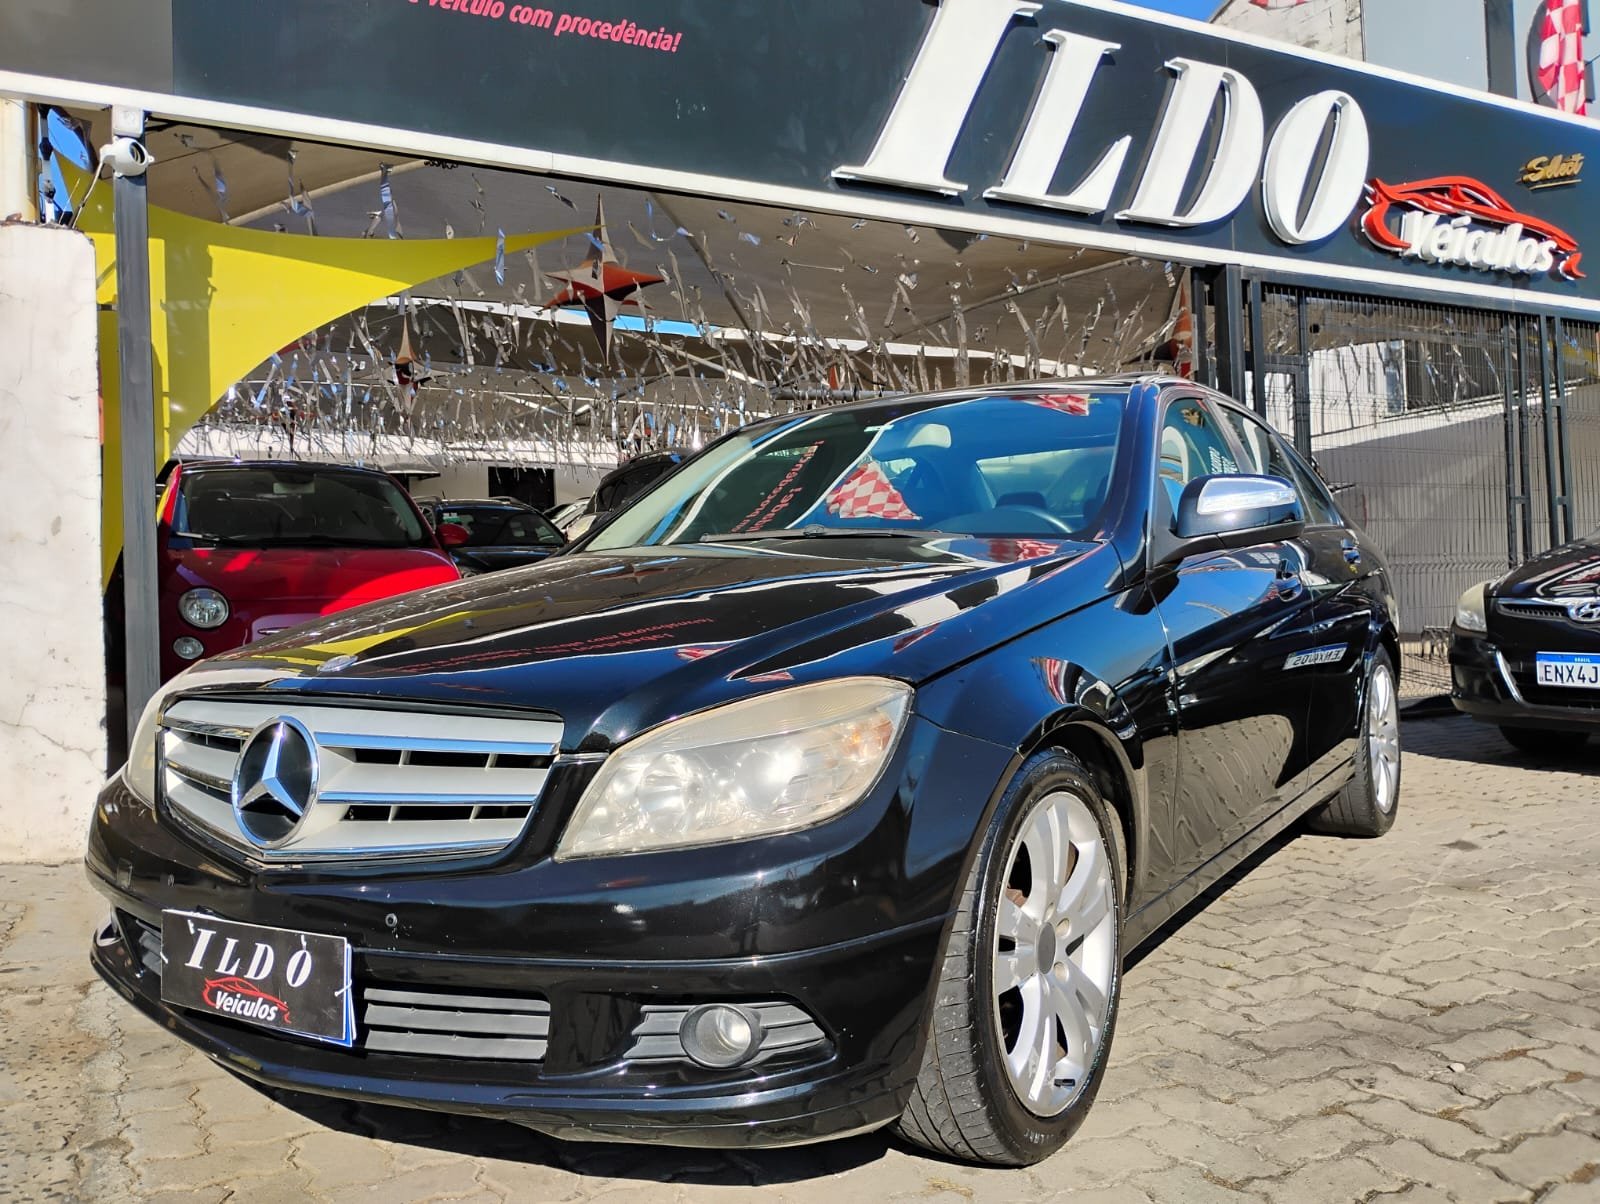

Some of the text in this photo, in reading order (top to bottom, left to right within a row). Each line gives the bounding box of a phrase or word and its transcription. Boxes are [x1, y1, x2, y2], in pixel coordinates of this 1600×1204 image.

[509, 4, 554, 29] com
[554, 14, 683, 53] procedência!
[830, 0, 1370, 246] ILDO
[1521, 152, 1585, 183] Select
[1400, 210, 1559, 275] Veículos
[1544, 664, 1599, 684] ENX4J
[184, 928, 313, 988] ILDO
